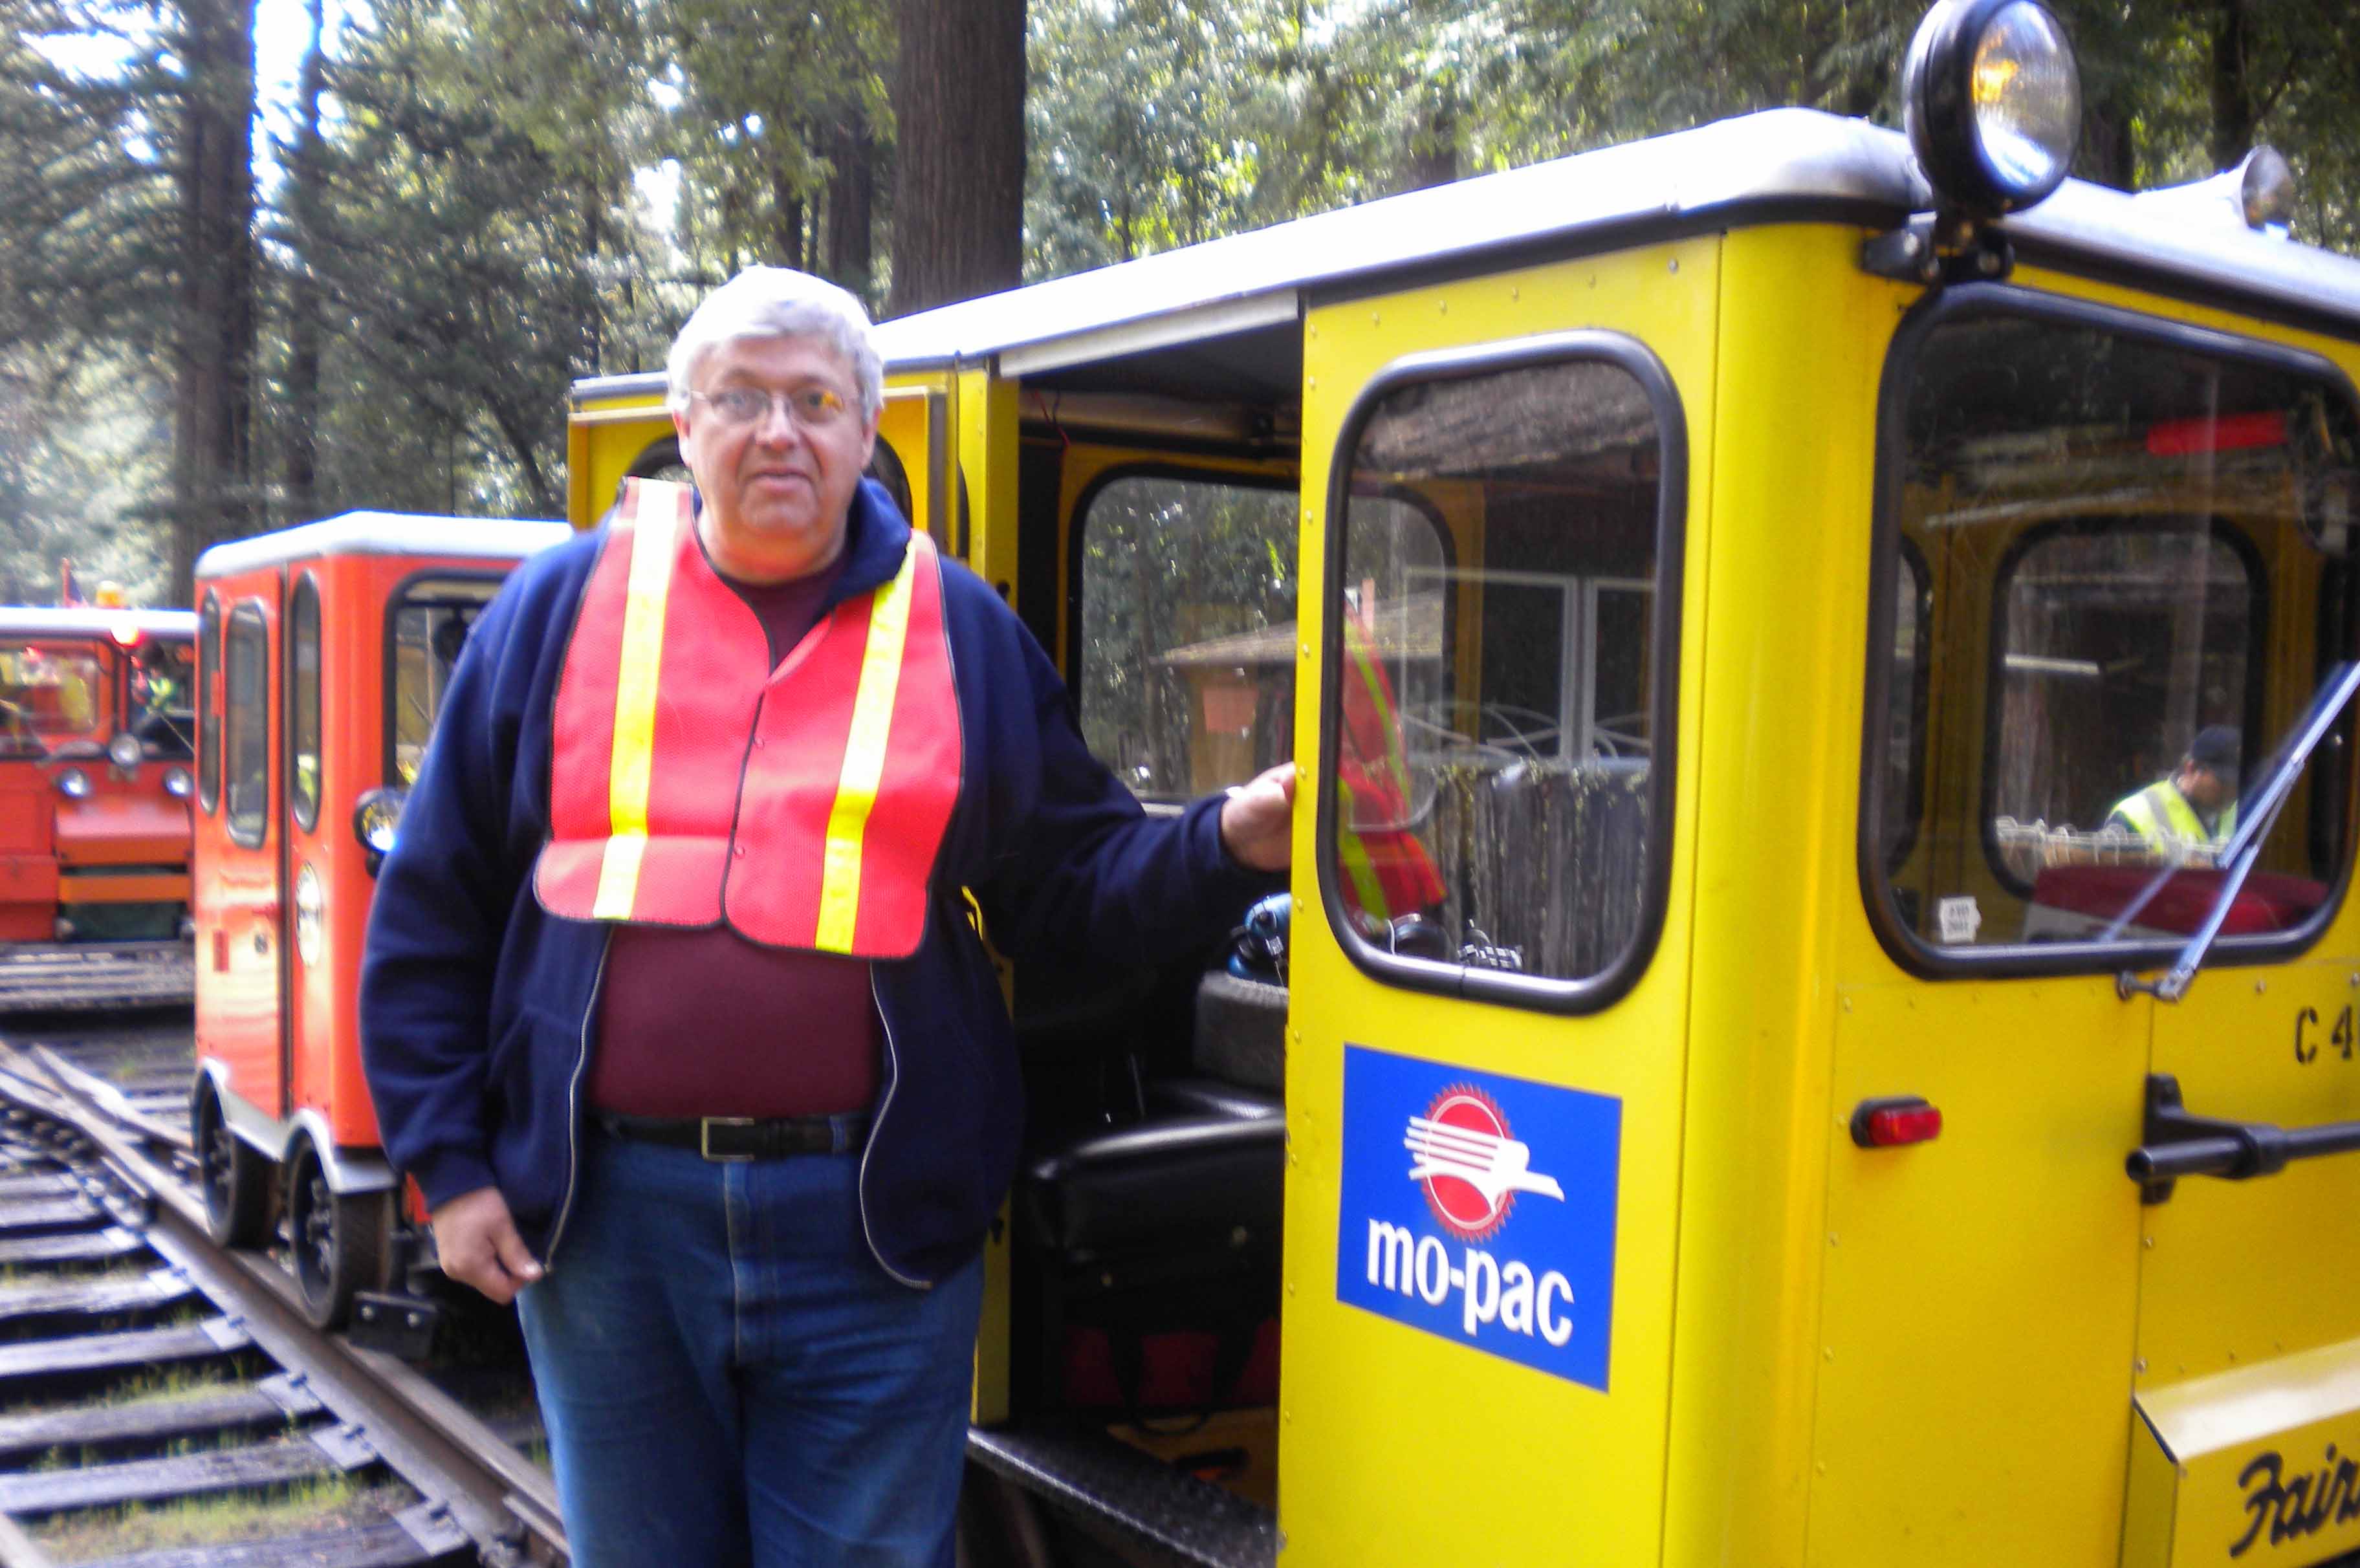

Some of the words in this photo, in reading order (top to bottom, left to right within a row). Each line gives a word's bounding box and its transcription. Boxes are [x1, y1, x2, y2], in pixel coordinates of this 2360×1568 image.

[2330, 1005, 2360, 1060] 4
[1367, 1218, 1574, 1346] mo-pac
[2229, 1443, 2360, 1558] Fair
